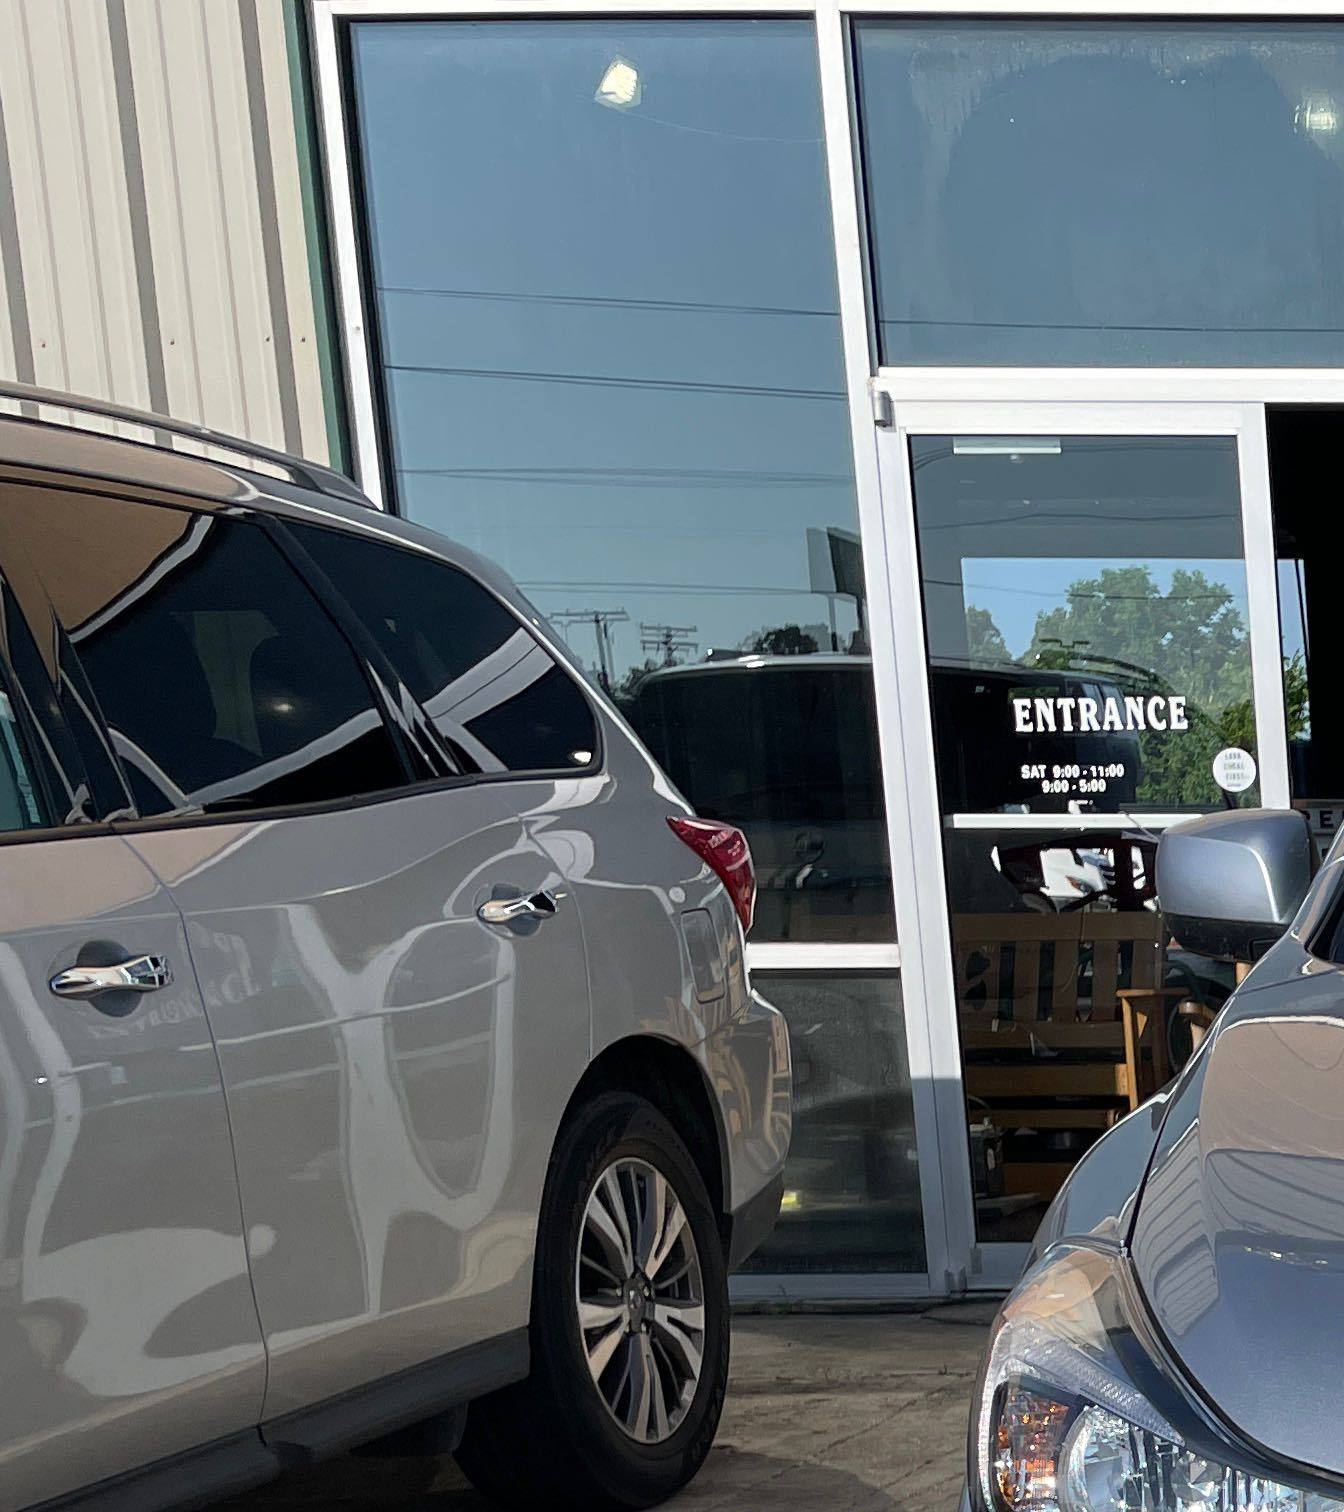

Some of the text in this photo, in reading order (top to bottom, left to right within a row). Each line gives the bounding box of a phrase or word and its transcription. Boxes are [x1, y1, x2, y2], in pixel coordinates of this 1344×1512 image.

[1012, 695, 1189, 733] ENTRANCE
[1020, 764, 1047, 779] SAT
[1052, 764, 1080, 778] 9:00
[1089, 763, 1125, 778] 11:00
[1041, 779, 1070, 793] 9:00
[1079, 779, 1107, 793] 5:00
